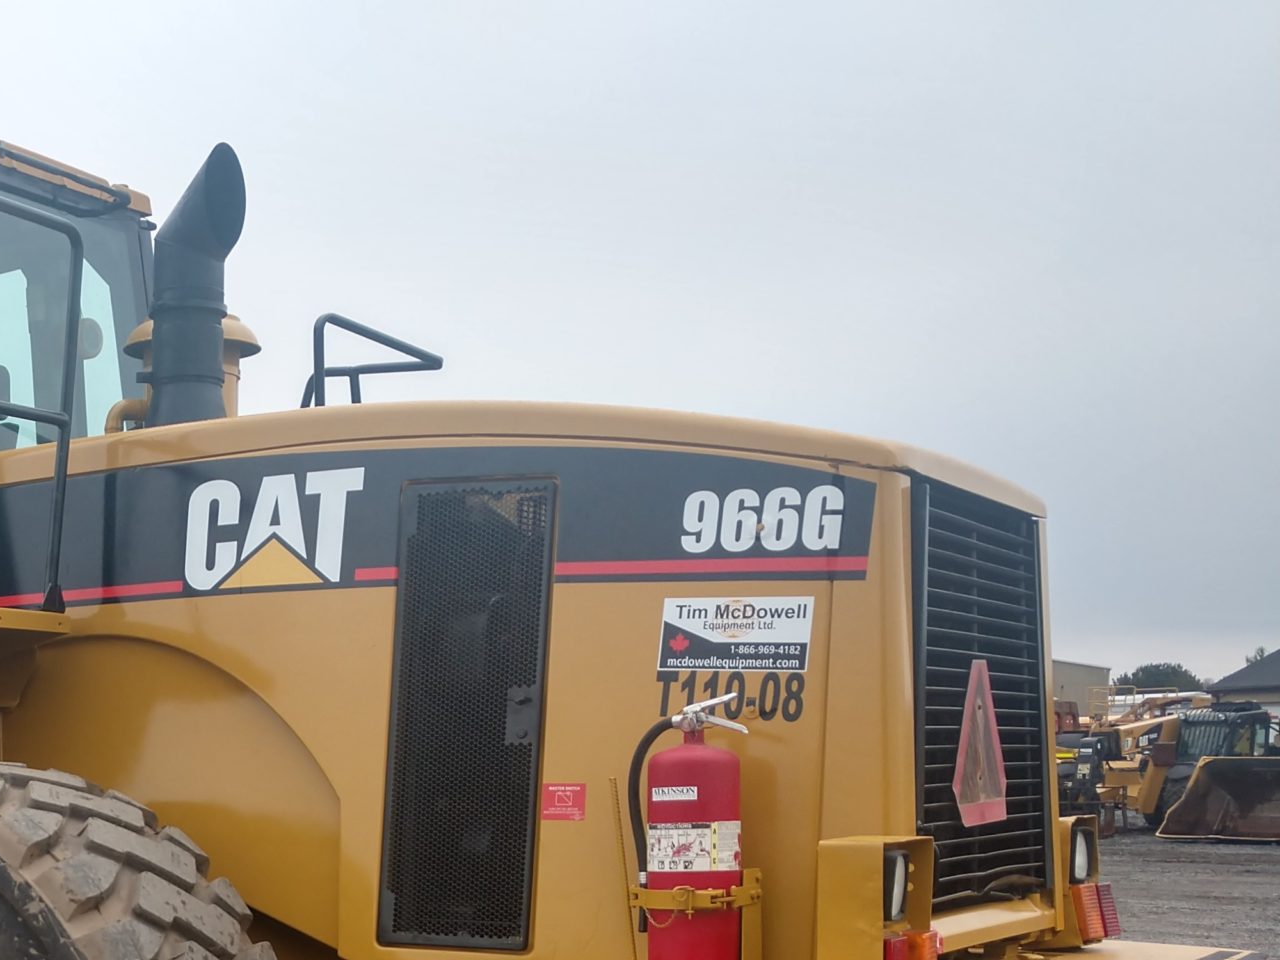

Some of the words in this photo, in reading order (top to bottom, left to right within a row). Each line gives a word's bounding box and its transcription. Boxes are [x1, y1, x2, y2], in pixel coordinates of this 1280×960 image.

[681, 485, 844, 554] 966G
[184, 467, 365, 591] CAT
[676, 604, 708, 619] Tim
[714, 603, 808, 619] McDowell
[703, 620, 755, 632] Equipment
[758, 620, 776, 630] Ltd.
[730, 645, 801, 655] 1-866-969-4182
[667, 656, 800, 669] mcdowellequipment.com
